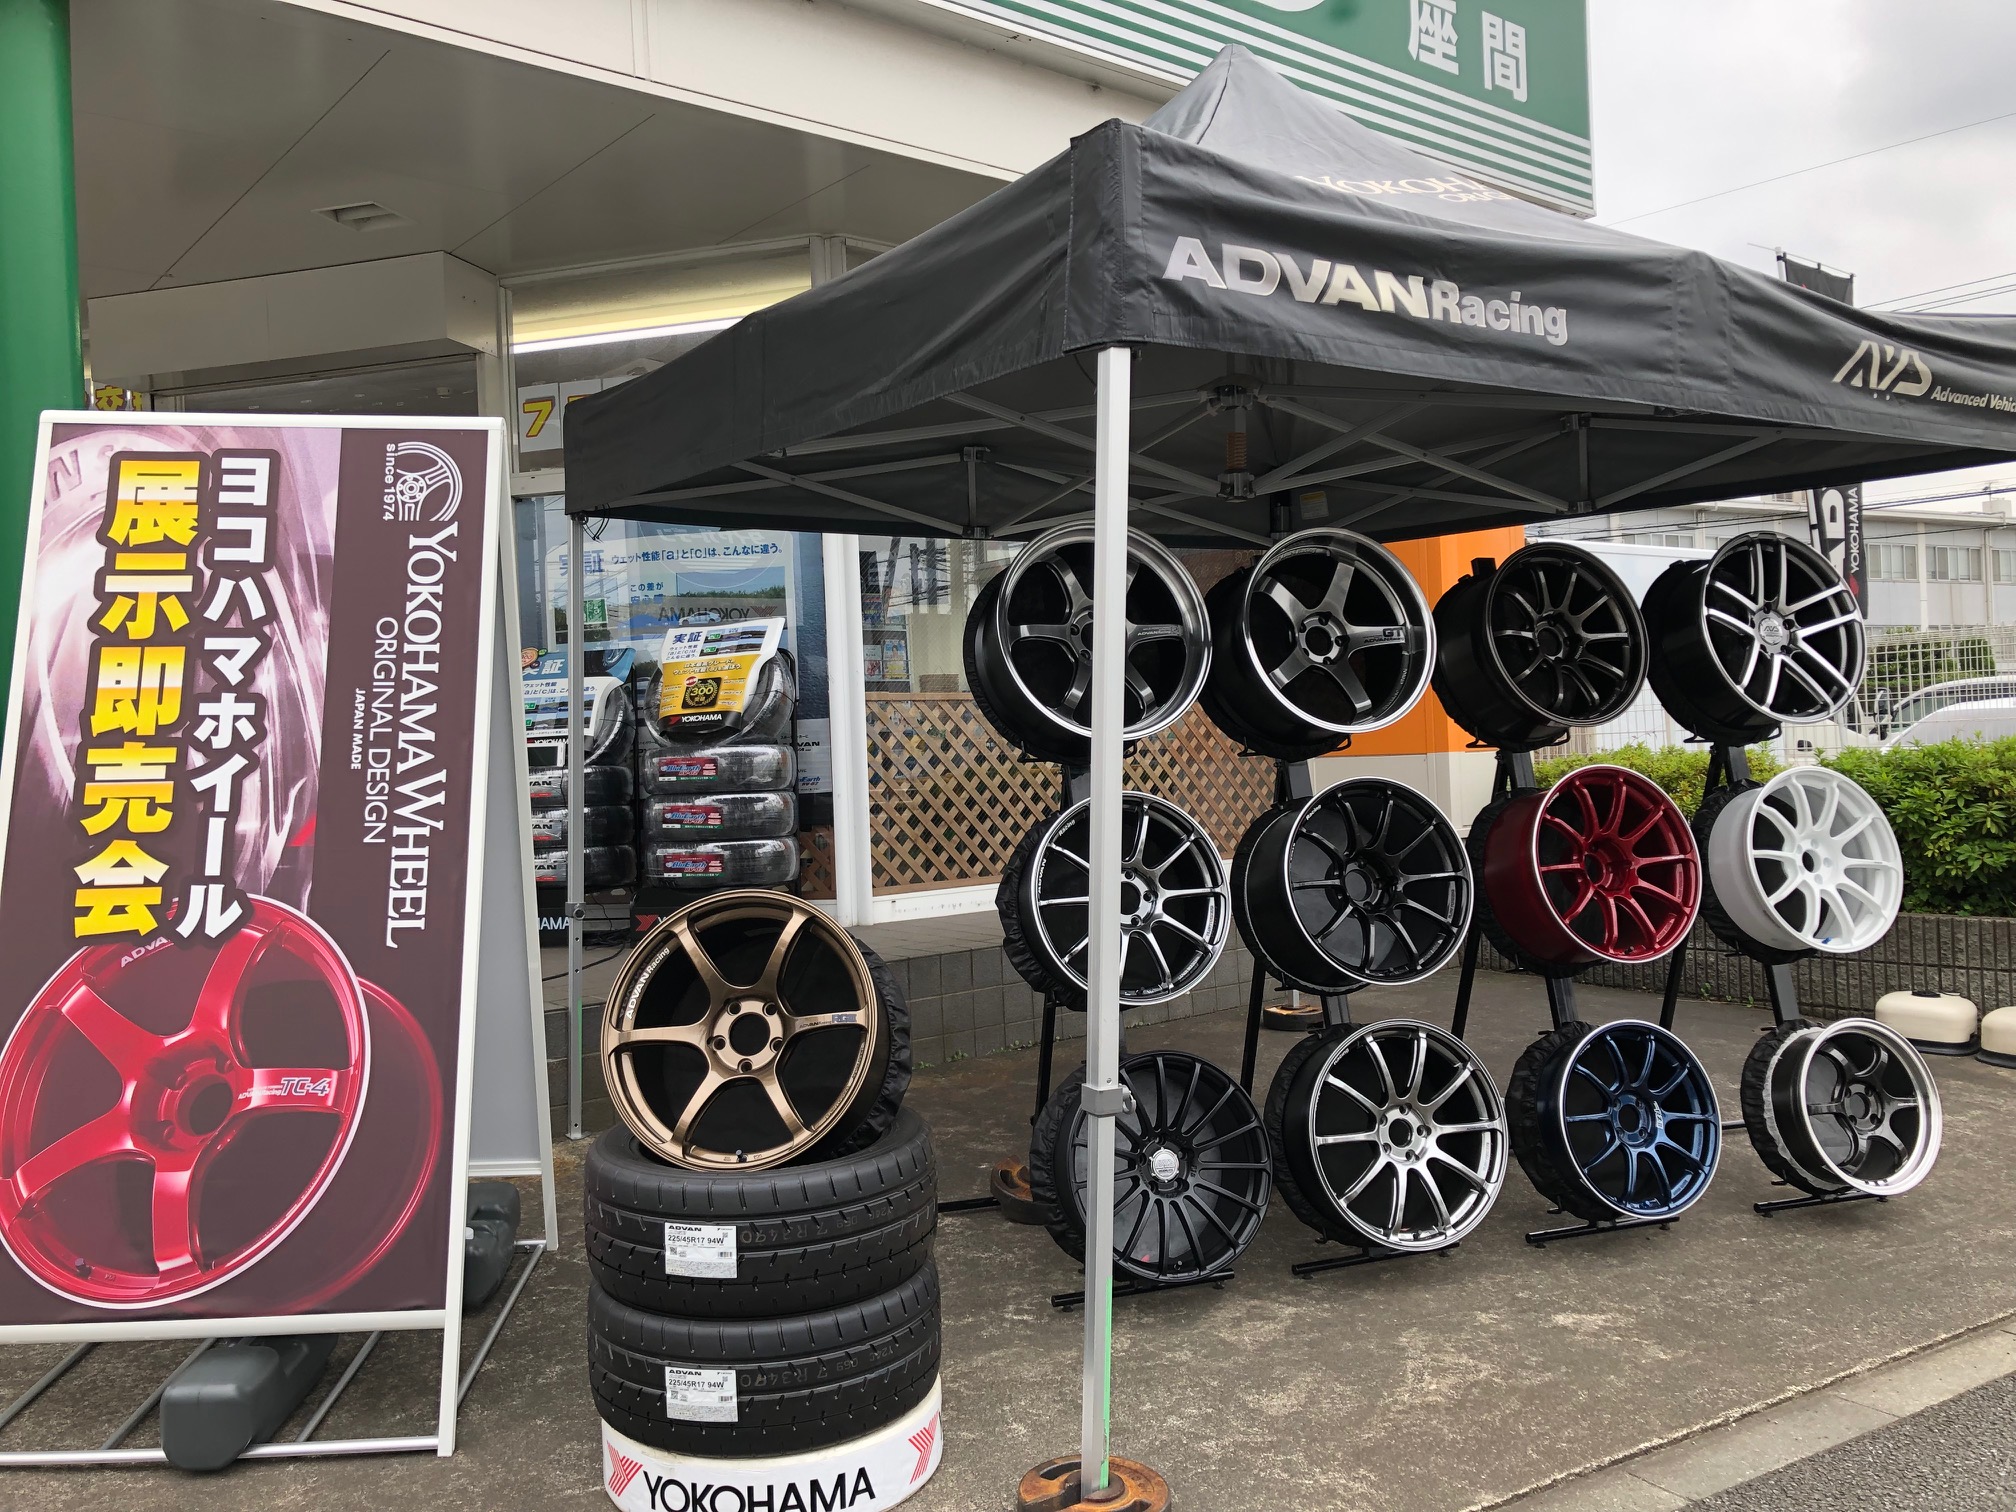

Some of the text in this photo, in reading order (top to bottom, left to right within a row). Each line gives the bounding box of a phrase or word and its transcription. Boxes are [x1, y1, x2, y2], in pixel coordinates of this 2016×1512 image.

[1408, 0, 1528, 102] 座間
[1162, 236, 1568, 346] ADVAN Racing
[95, 385, 142, 411] 交
[1930, 386, 1989, 407] Advanced
[382, 443, 398, 521] since 1974
[1848, 487, 1860, 574] YOKOHAMA
[672, 631, 703, 645] 実証
[74, 459, 200, 938] 展示即売会
[175, 456, 270, 939] ヨコハマホイール
[691, 687, 714, 696] 300
[350, 688, 366, 770] JAPAN MADE
[363, 617, 398, 843] ORIGINAL DESIGN
[681, 714, 722, 722] YOKOHAMA
[121, 936, 170, 968] ADVA
[625, 947, 670, 1020] ADVAN Racing
[281, 1077, 332, 1096] TC-4
[667, 1234, 724, 1244] 225/45R17 94W
[668, 1378, 706, 1388] 225/45R17
[643, 1467, 877, 1512] YOKOHAMA
